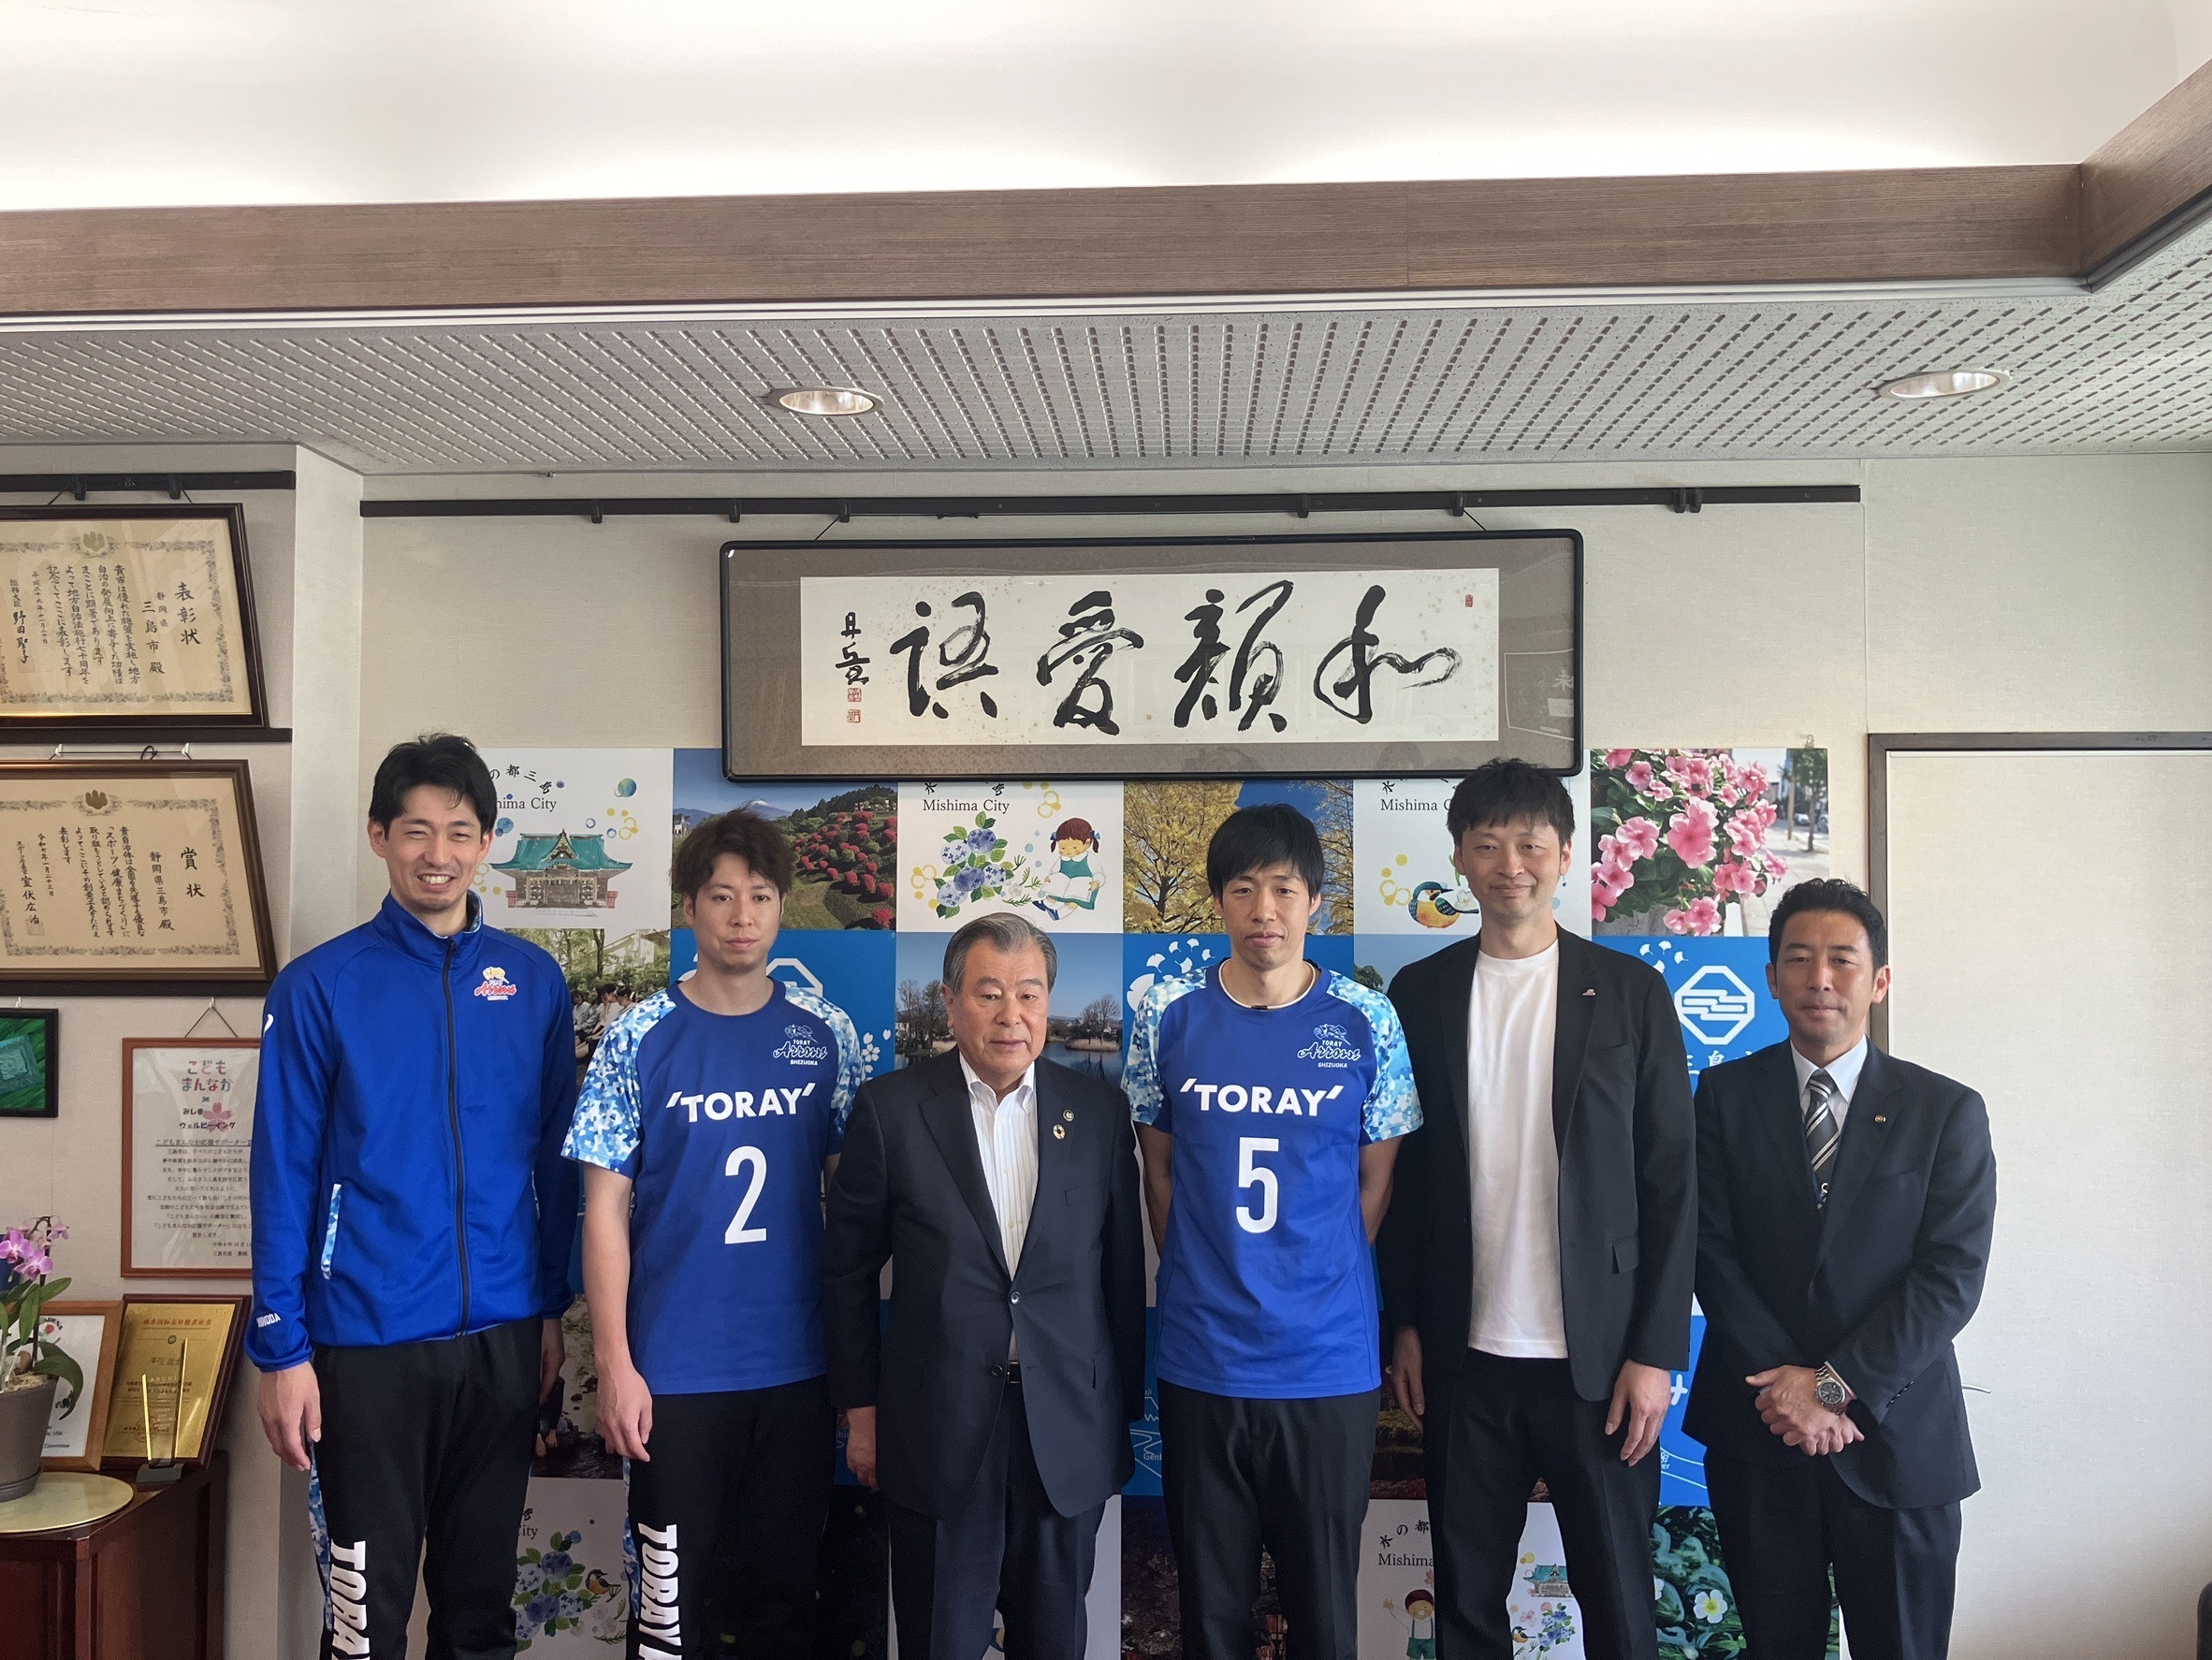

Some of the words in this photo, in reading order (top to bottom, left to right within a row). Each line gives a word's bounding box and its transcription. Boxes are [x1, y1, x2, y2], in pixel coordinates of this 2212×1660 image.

[47, 565, 73, 677] 記念してここに表彰します
[65, 565, 90, 684] よって地方自治法施行七十周年を
[156, 592, 169, 627] 静岡県
[175, 582, 201, 646] 表彰状
[489, 764, 552, 794] の都三島
[531, 797, 557, 813] City
[923, 799, 978, 811] Mishima
[983, 799, 1010, 814] City
[1380, 799, 1438, 811] Mishima
[59, 826, 71, 865] 表彰します
[181, 847, 205, 898] 賞状
[22, 876, 40, 925] 室伏広治
[773, 1041, 828, 1059] Arrows
[1297, 1041, 1361, 1061] Arrows
[187, 1060, 226, 1075] こども
[182, 1077, 234, 1092] まんなか
[724, 1145, 767, 1245] 2
[1236, 1137, 1279, 1233] 5
[519, 1524, 538, 1539] ity
[1379, 1519, 1430, 1550] 水の都
[1378, 1553, 1434, 1566] Mishima
[329, 1538, 371, 1660] TORA
[637, 1522, 682, 1646] TORAY
